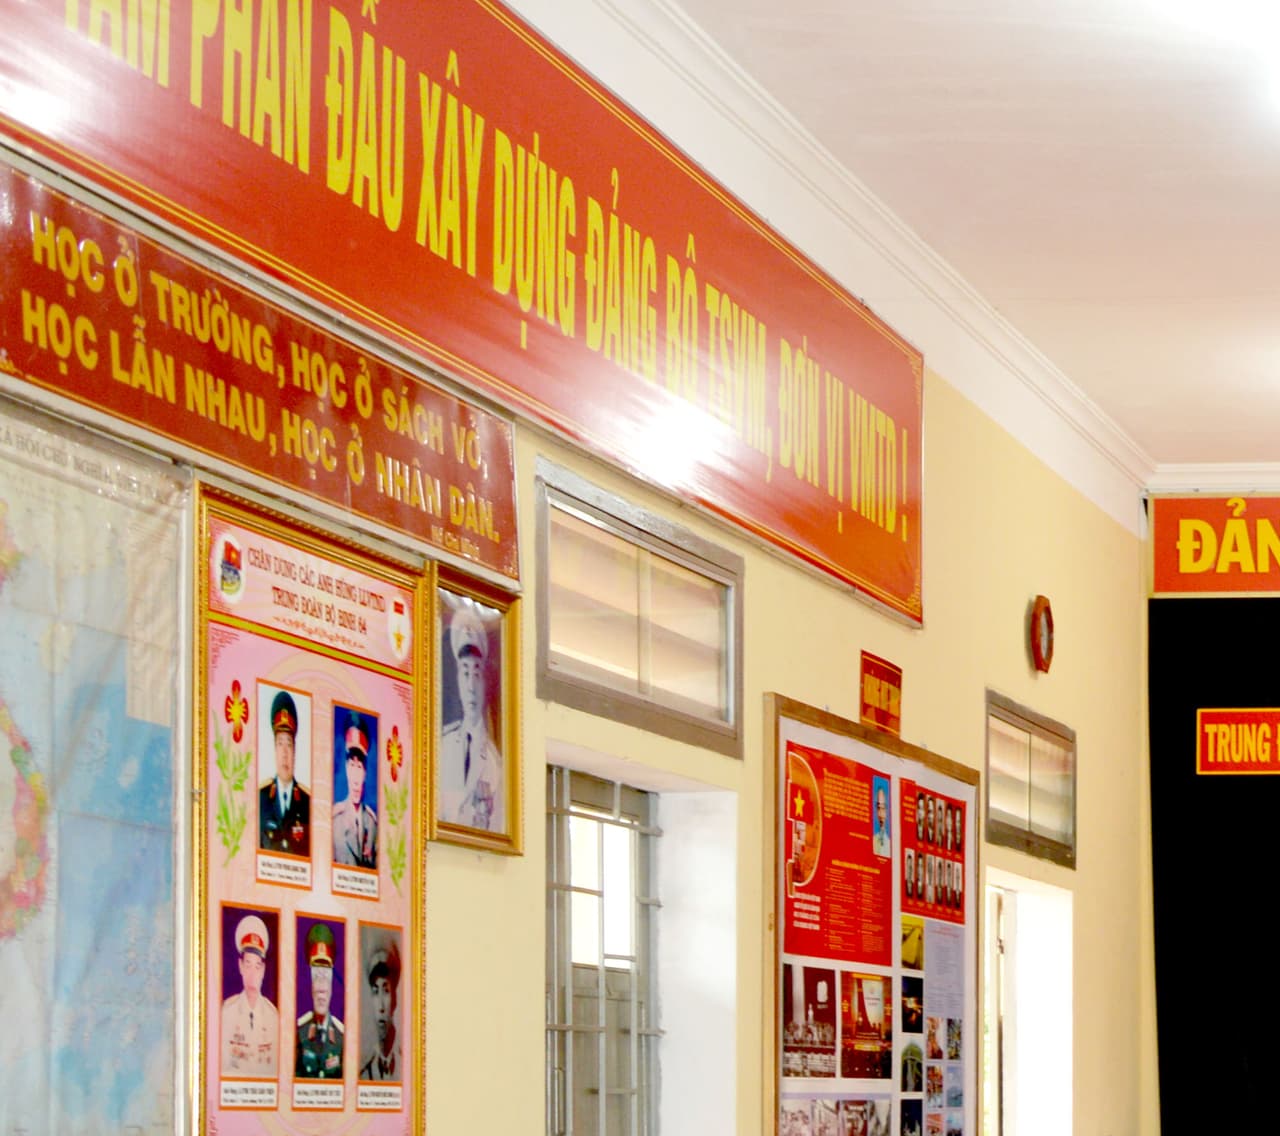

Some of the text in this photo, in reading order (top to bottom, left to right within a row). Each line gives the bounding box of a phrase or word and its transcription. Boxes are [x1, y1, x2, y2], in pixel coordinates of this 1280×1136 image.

[21, 288, 98, 376] HỌC
[109, 314, 176, 404] LẪN
[184, 363, 277, 456] NHAU,
[282, 409, 337, 480] HỌC
[346, 423, 365, 486] Ở
[375, 452, 442, 519] NHÂN
[30, 209, 105, 298] HỌC
[113, 234, 139, 308] Ở
[150, 270, 286, 389] TRƯỜNG,
[291, 341, 347, 413] HỌC
[354, 357, 373, 419] Ở
[382, 385, 444, 455] SÁCH
[415, 49, 485, 278] XÂY
[493, 128, 576, 349] DỰNG
[584, 167, 658, 384] ĐẢNG
[779, 335, 820, 488] ĐƠN
[825, 370, 844, 534] VỊ
[1205, 722, 1271, 763] TRUNG
